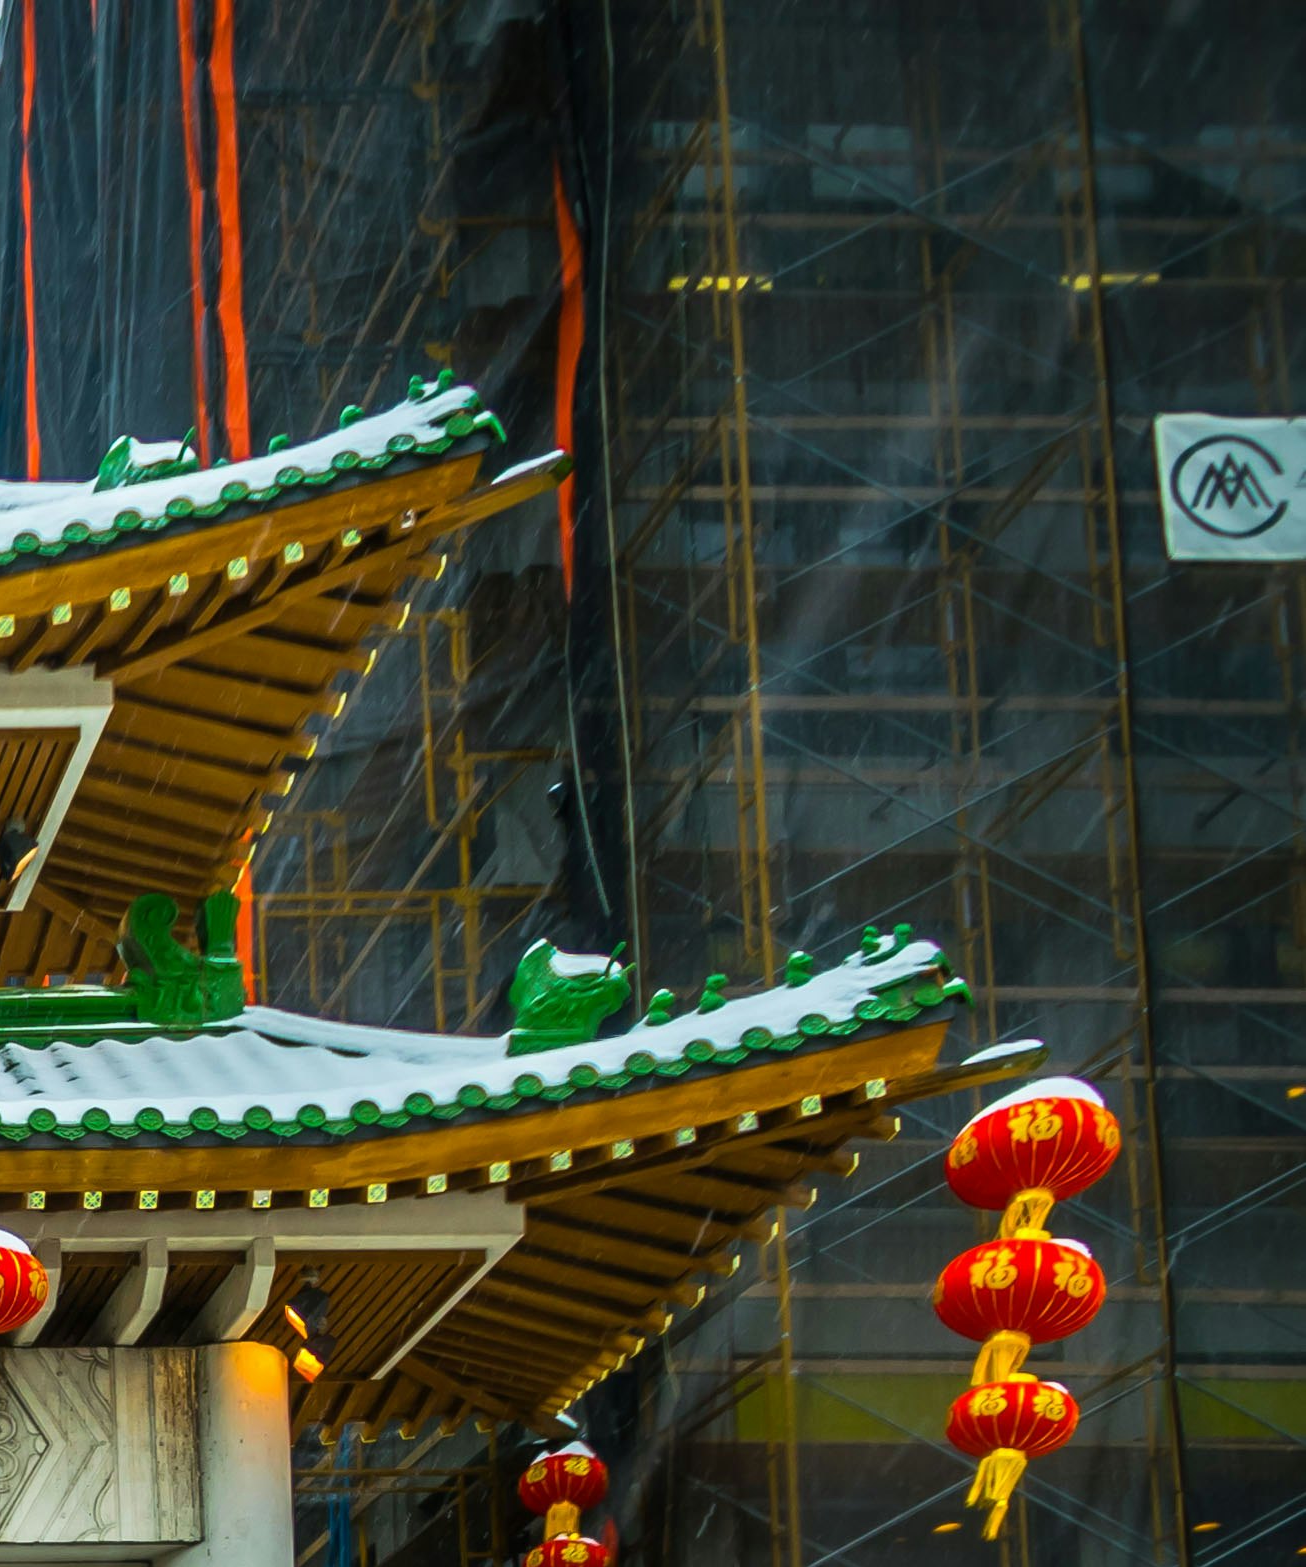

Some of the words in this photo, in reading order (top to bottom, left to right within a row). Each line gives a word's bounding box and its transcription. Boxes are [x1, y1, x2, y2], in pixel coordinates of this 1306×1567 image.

[1007, 1100, 1063, 1143] 福
[969, 1248, 1019, 1290] 福
[1053, 1252, 1094, 1298] 福
[969, 1386, 1008, 1417] 福
[1033, 1387, 1067, 1422] 福
